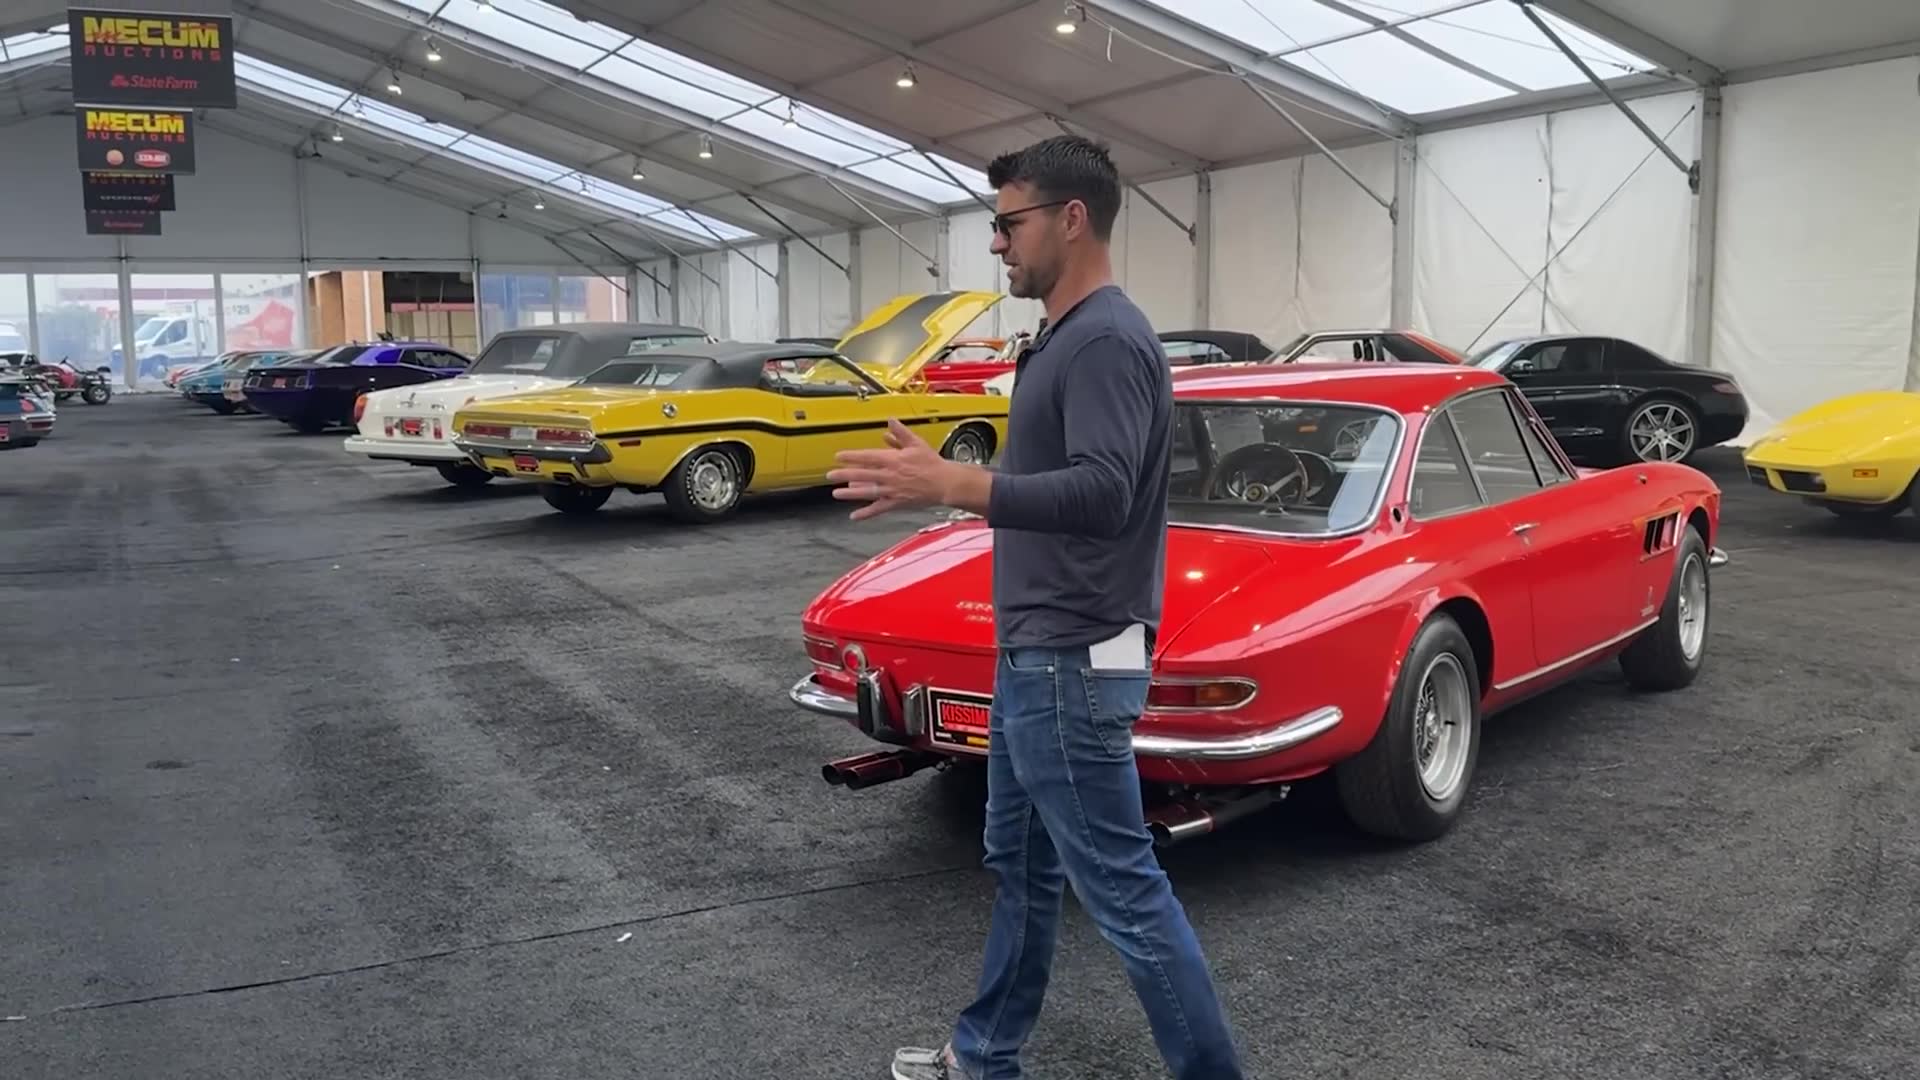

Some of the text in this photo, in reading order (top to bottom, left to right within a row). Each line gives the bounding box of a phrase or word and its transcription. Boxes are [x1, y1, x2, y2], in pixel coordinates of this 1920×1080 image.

[83, 16, 220, 49] MECUM
[84, 45, 222, 61] AUCTIONS
[86, 111, 185, 133] MECUM
[86, 131, 186, 143] AUCTIONS
[941, 703, 991, 726] KISSIM
